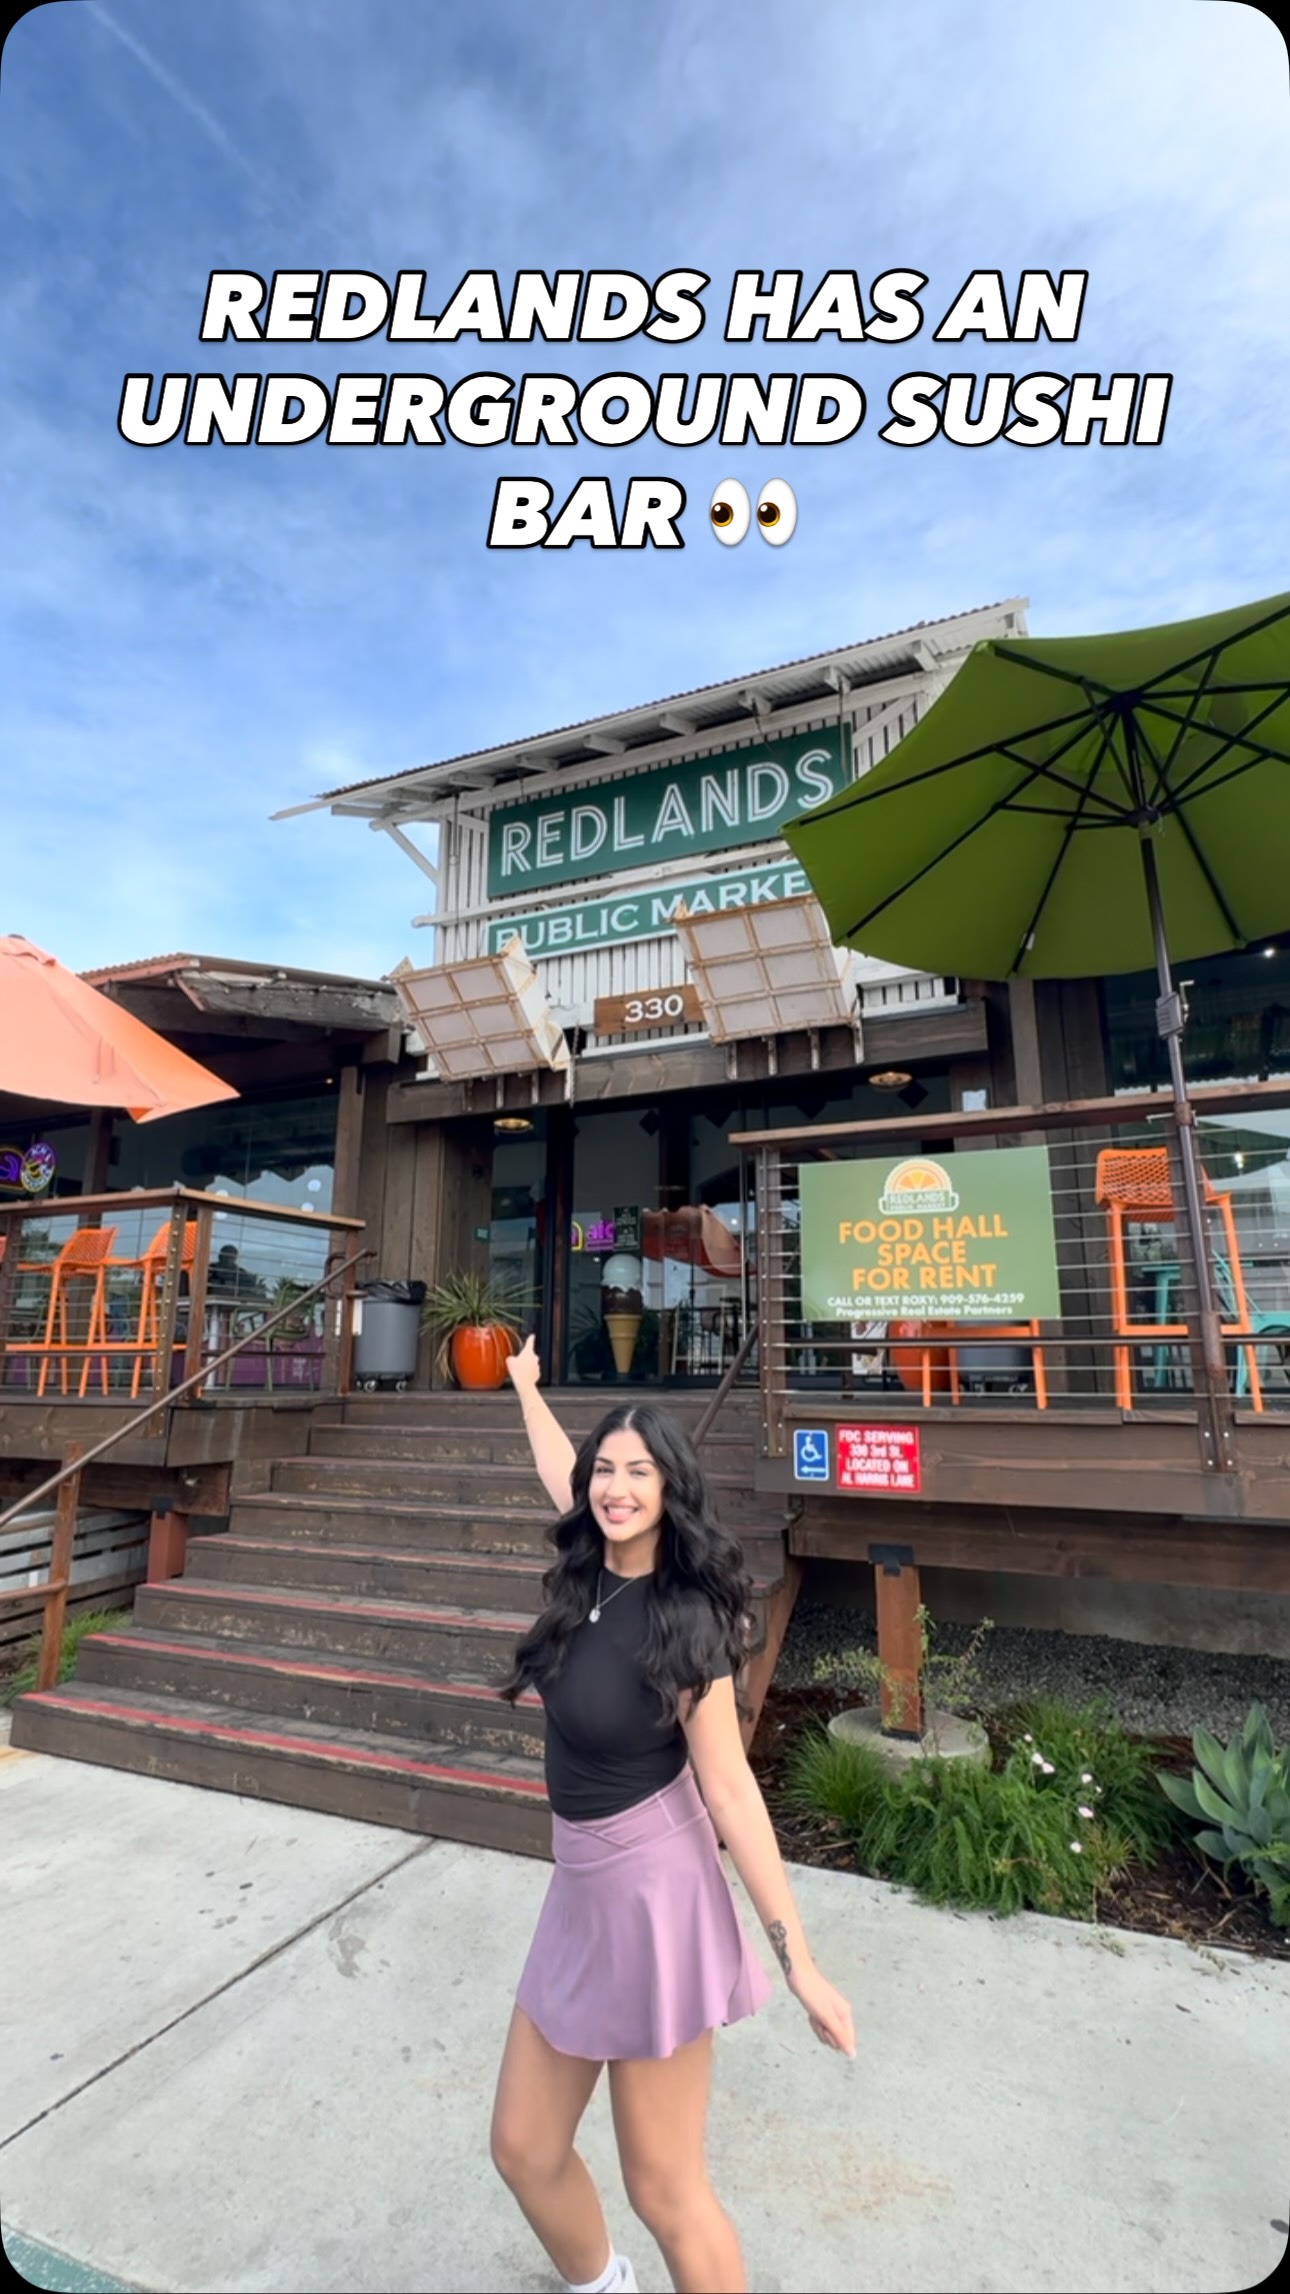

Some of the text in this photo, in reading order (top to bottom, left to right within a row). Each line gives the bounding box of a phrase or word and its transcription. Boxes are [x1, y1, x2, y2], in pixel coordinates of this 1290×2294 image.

[501, 749, 834, 877] REDLANDS
[495, 869, 813, 951] PUBLIC MARKE
[624, 993, 684, 1024] 330
[839, 1214, 1008, 1245] FOOD HALL
[877, 1240, 967, 1267] SPACE
[852, 1263, 997, 1291] FOR RENT
[826, 1297, 851, 1307] CALL
[855, 1296, 872, 1307] OR
[874, 1296, 899, 1306] TEXT
[836, 1304, 1013, 1319] Progressive Real Estate Partners
[864, 1430, 914, 1445] SERVING
[846, 1458, 909, 1474] LOCATED ON
[890, 1473, 915, 1488] LANE
